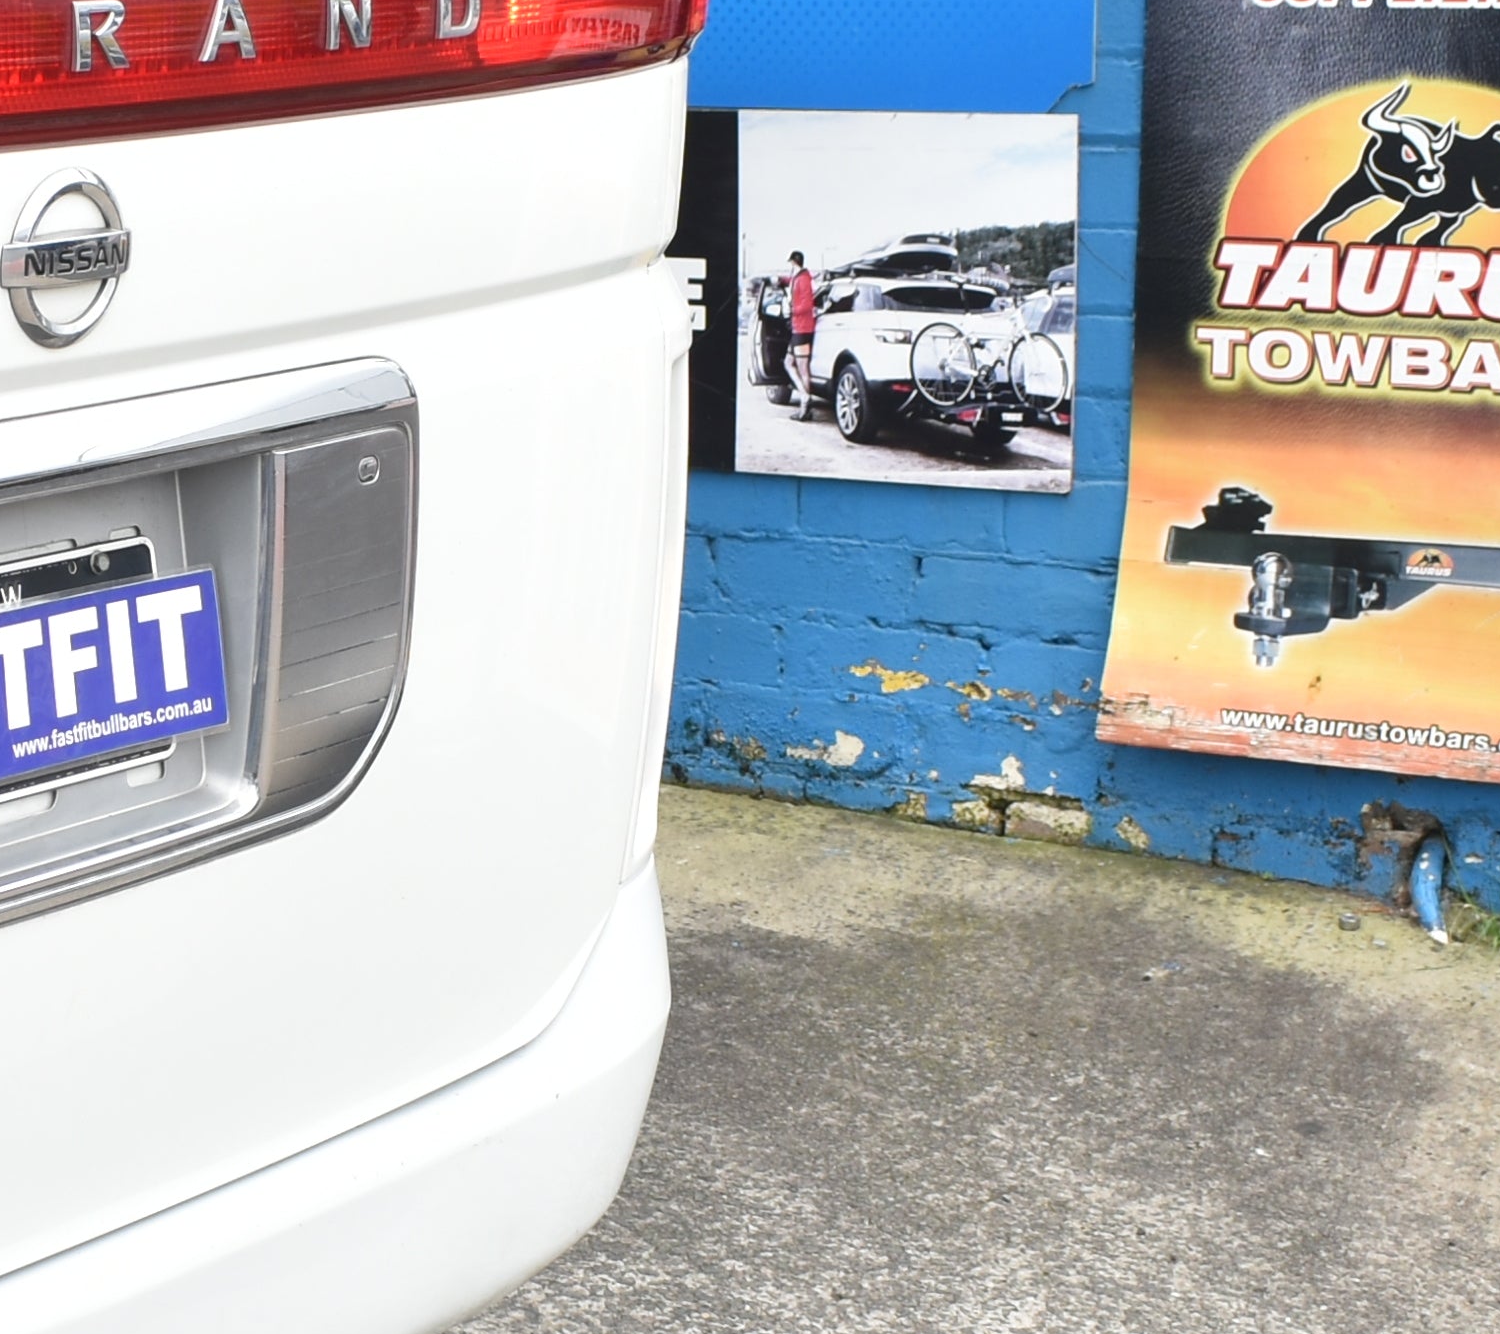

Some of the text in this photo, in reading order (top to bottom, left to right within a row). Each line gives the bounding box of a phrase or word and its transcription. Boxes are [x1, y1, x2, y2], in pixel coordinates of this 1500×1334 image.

[24, 239, 126, 277] NISSAN
[1405, 565, 1452, 578] TAURUS
[12, 696, 213, 759] www.fastfitbullbars.com.au
